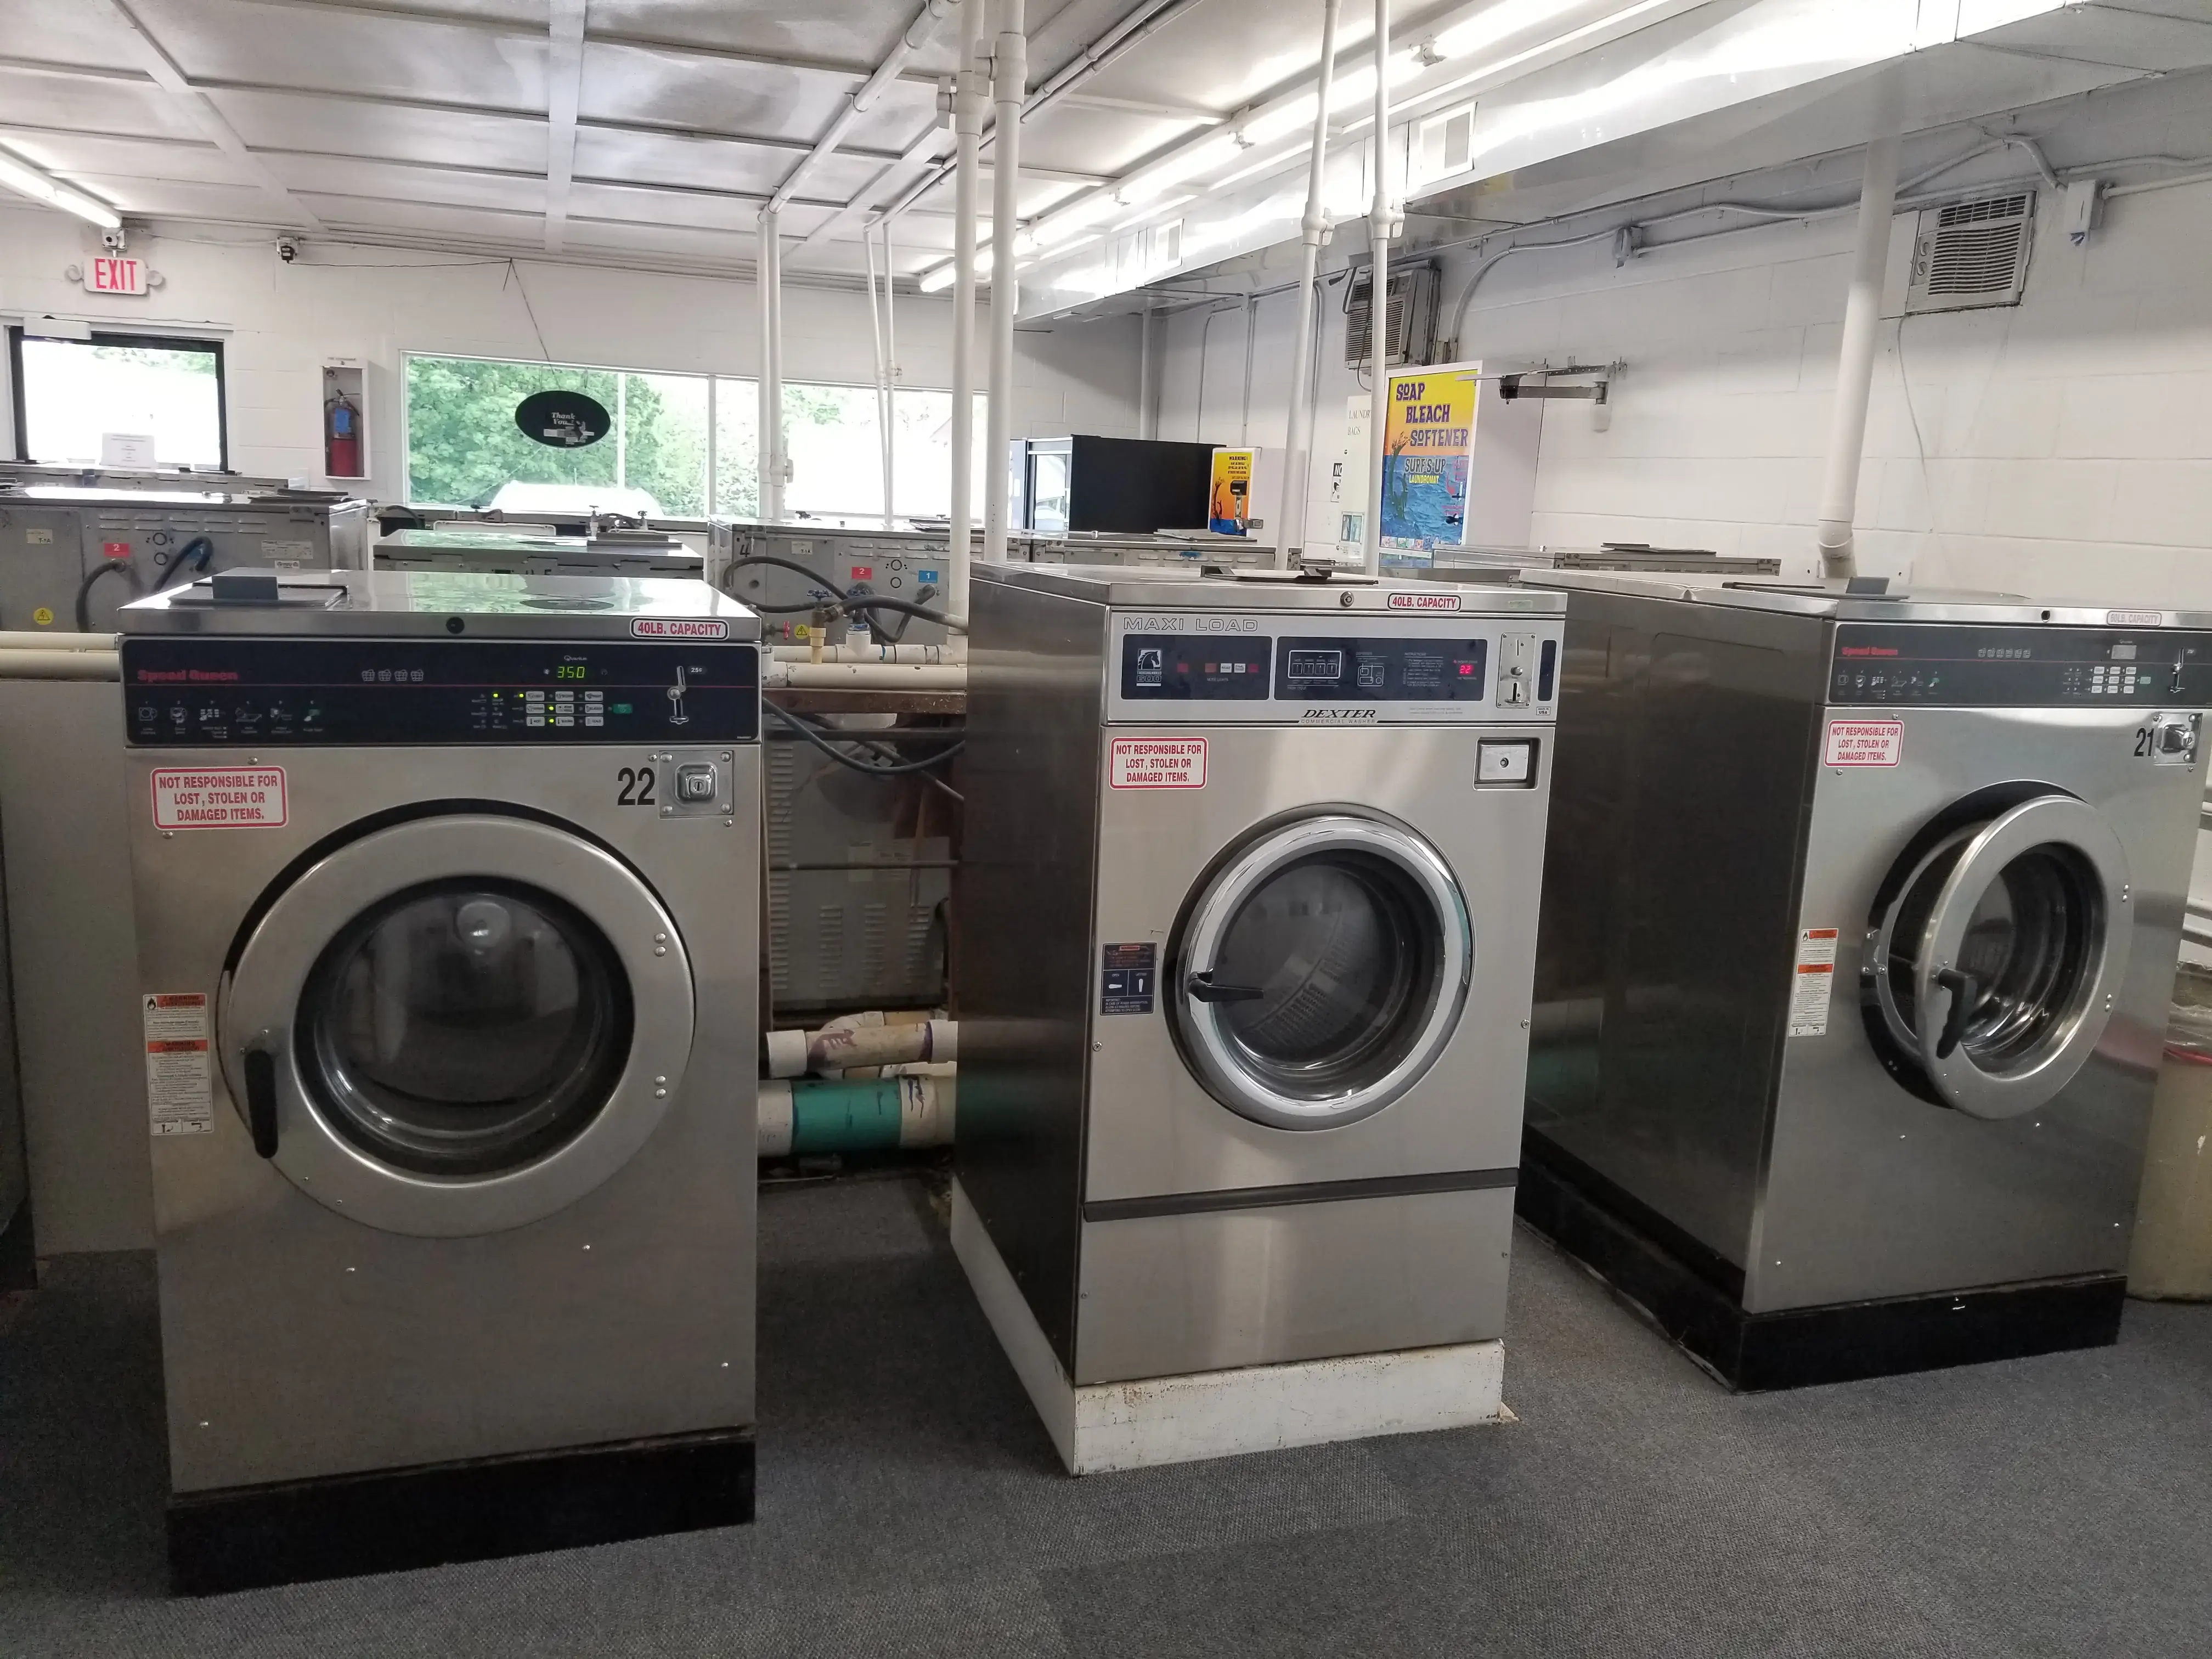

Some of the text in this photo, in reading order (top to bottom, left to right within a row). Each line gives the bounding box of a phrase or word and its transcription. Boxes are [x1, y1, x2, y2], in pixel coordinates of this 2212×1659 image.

[95, 258, 137, 291] EXIT
[1396, 381, 1425, 402] SOAP
[1348, 409, 1372, 419] LAUNDR
[1406, 404, 1451, 424] BLEACH
[1347, 426, 1361, 435] BAGS
[1410, 428, 1469, 447] SOFTENER
[1404, 458, 1433, 473] SURF'S
[1435, 458, 1446, 473] UP
[1409, 475, 1440, 484] LAUNDROMAT
[114, 544, 120, 552] 2
[740, 543, 750, 557] 4
[1392, 596, 1456, 608] 40LB. CAPACITY
[1124, 617, 1257, 631] MAXI LOAD
[2129, 614, 2158, 624] CAPACITY
[637, 622, 721, 636] 40LB. CAPACITY
[557, 666, 585, 678] 350
[1459, 665, 1471, 674] 22
[1301, 709, 1376, 718] DEXTER
[1832, 727, 1898, 736] NOT RESPONSIBLE FOR
[1857, 740, 1880, 748] STOLEN
[1881, 740, 1889, 748] OR
[2134, 727, 2154, 757] 21
[1116, 744, 1201, 754] NOT RESPONSIBLE FOR
[1838, 752, 1886, 760] DAMAGED ITEMS.
[1150, 758, 1178, 768] STOLEN
[1181, 758, 1191, 768] OR
[159, 775, 278, 788] NOT RESPONSIBLE FOR
[1126, 772, 1189, 782] DAMAGED ITEMS.
[617, 767, 655, 805] 22
[208, 792, 247, 804] STOLEN
[251, 792, 265, 803] OR
[177, 808, 264, 821] DAMAGED ITEMS.
